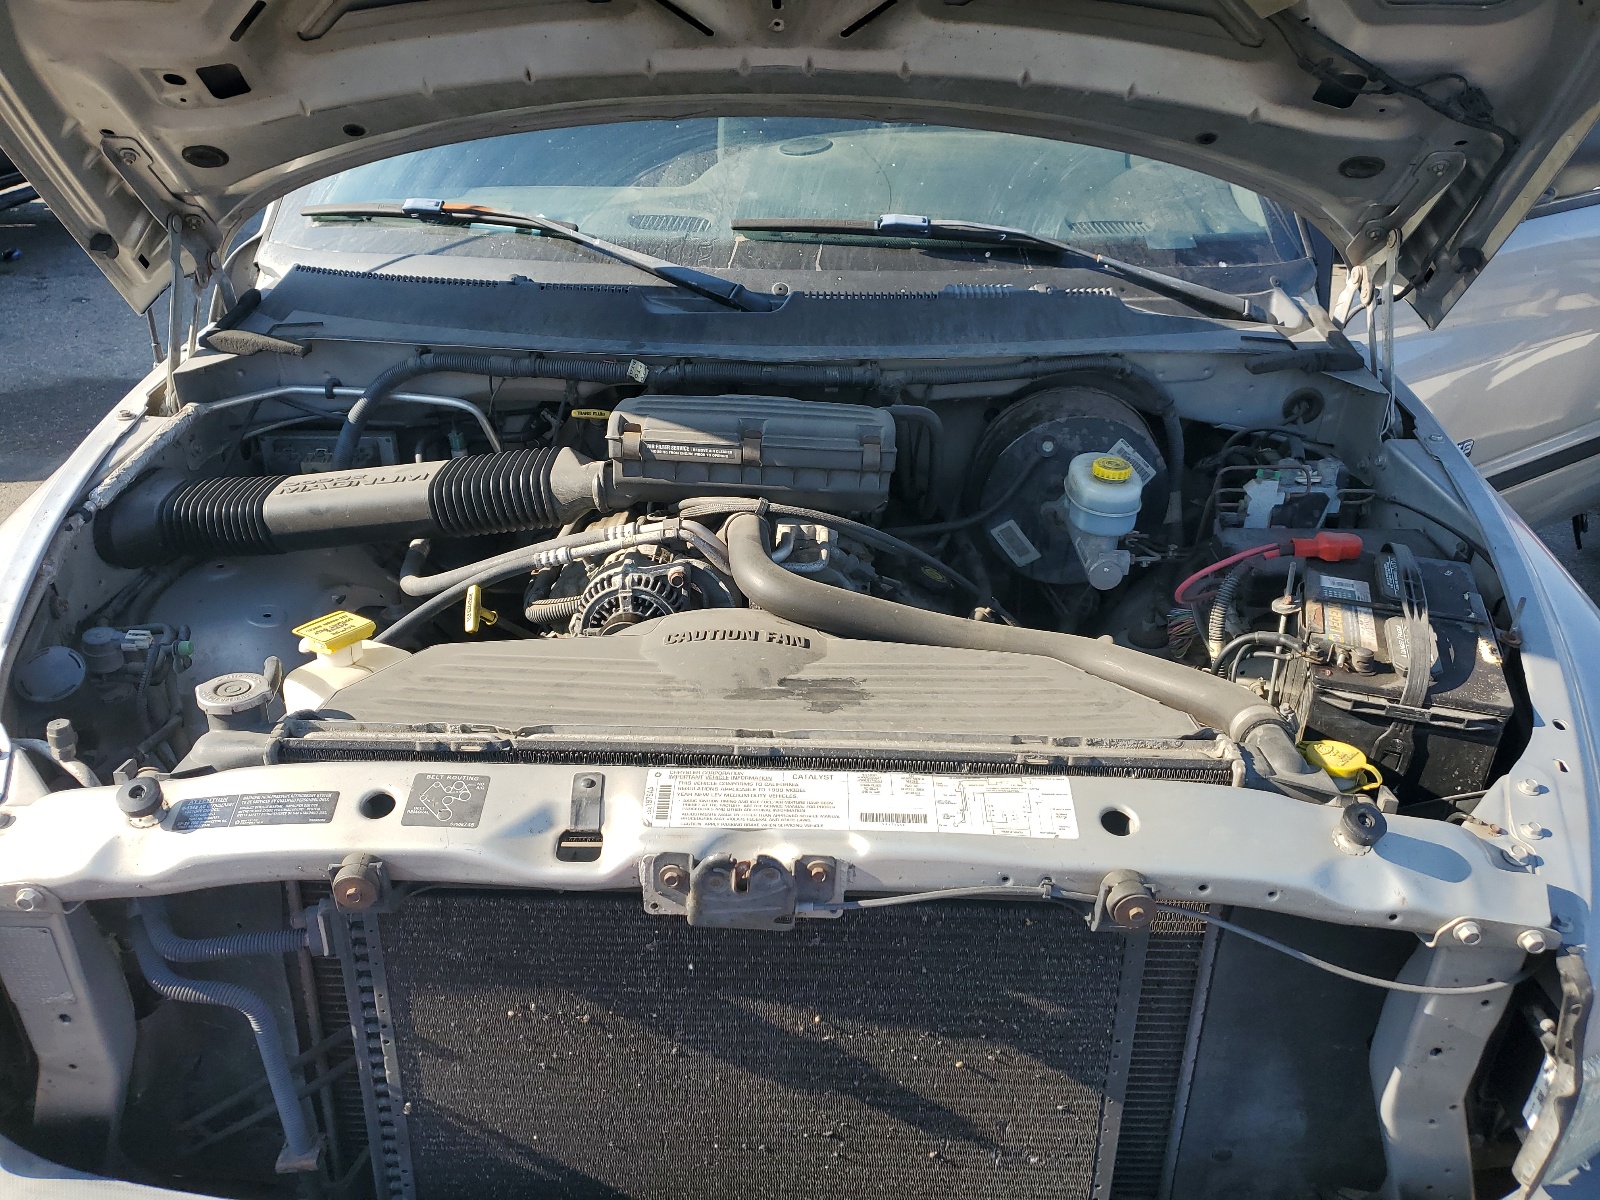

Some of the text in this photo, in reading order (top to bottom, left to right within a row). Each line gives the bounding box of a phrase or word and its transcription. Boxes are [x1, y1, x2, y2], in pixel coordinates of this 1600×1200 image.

[275, 472, 430, 496] MAGNUM
[663, 629, 812, 650] CAUTION FAN
